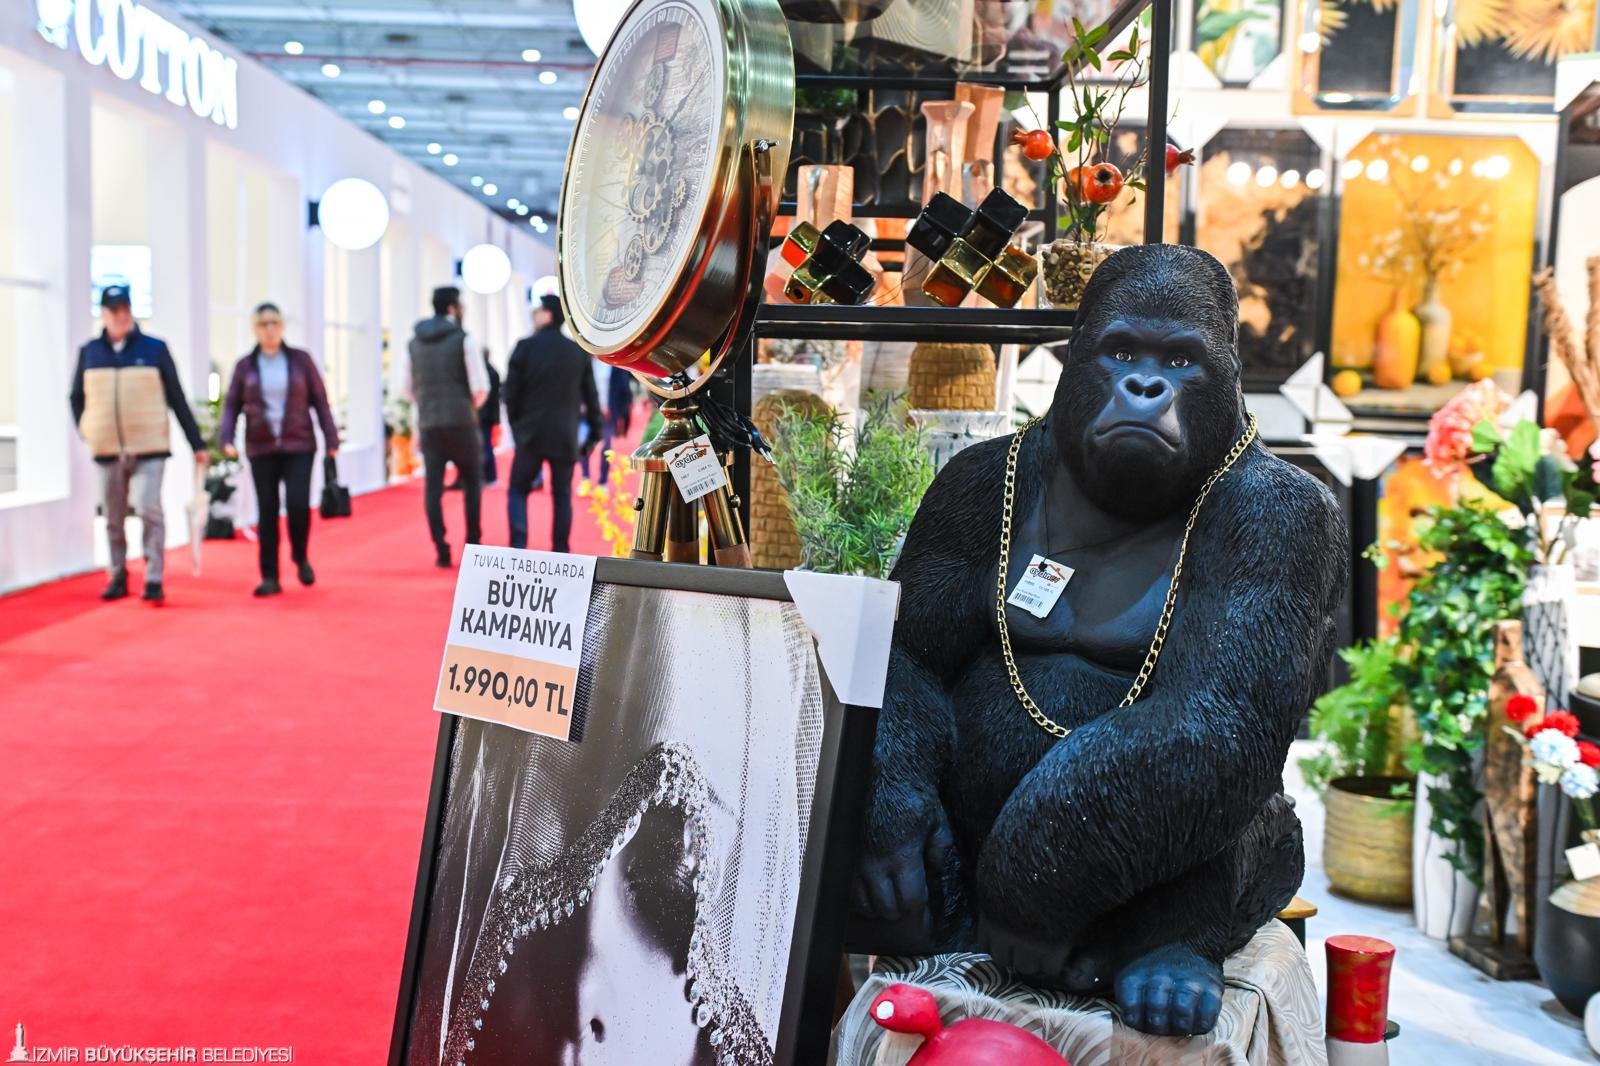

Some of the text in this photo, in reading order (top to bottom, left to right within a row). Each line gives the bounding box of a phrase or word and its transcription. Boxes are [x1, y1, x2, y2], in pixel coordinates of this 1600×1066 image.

[74, 0, 238, 130] COTTON
[474, 554, 585, 579] TUVAL TABLOLARDA
[487, 574, 558, 614] BÜYÜK
[460, 607, 572, 651] KAMPANYA
[449, 663, 569, 716] 1.990,00 TL
